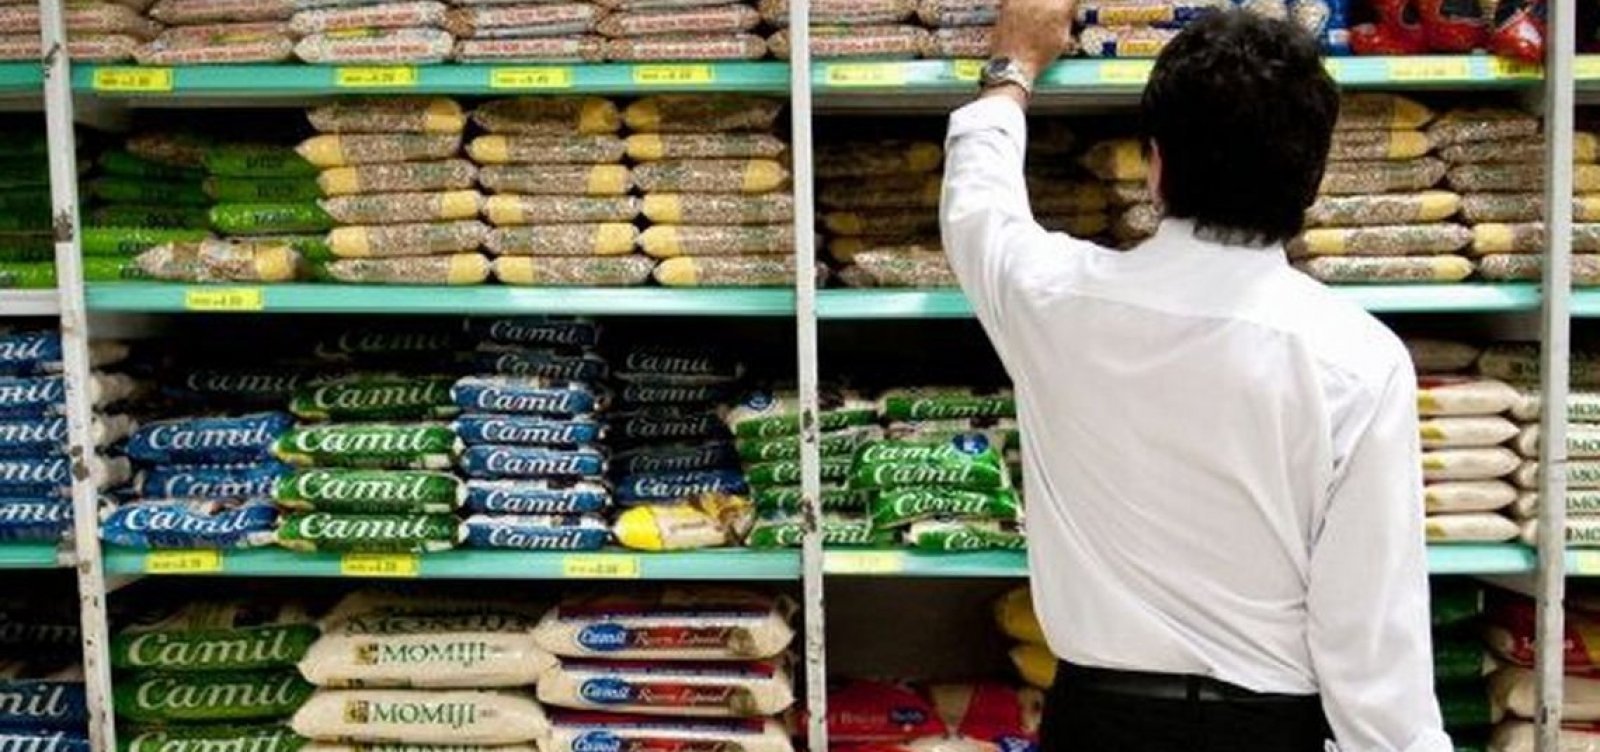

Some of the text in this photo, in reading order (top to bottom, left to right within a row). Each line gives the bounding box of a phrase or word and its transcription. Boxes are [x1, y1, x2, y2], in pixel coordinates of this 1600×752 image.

[490, 320, 579, 344] Camil
[497, 354, 584, 377] Camil
[314, 382, 439, 409] Camil
[479, 387, 571, 411] Camil
[911, 400, 1001, 419] Camil
[150, 421, 272, 449] Camil
[297, 427, 435, 452] Camil
[482, 420, 577, 444] Camil
[486, 450, 582, 474] Camil
[874, 462, 973, 485] Camil
[299, 471, 433, 500] Camil
[635, 476, 721, 497] Camil
[486, 490, 579, 513] Camil
[895, 492, 988, 516] Camil
[125, 508, 250, 533] Camil
[300, 512, 435, 539] Camil
[489, 527, 584, 550] Camil
[129, 630, 291, 667] Camil
[382, 643, 487, 667] MOMIJI
[138, 676, 296, 709] Camil
[373, 703, 477, 729] MOMIJI
